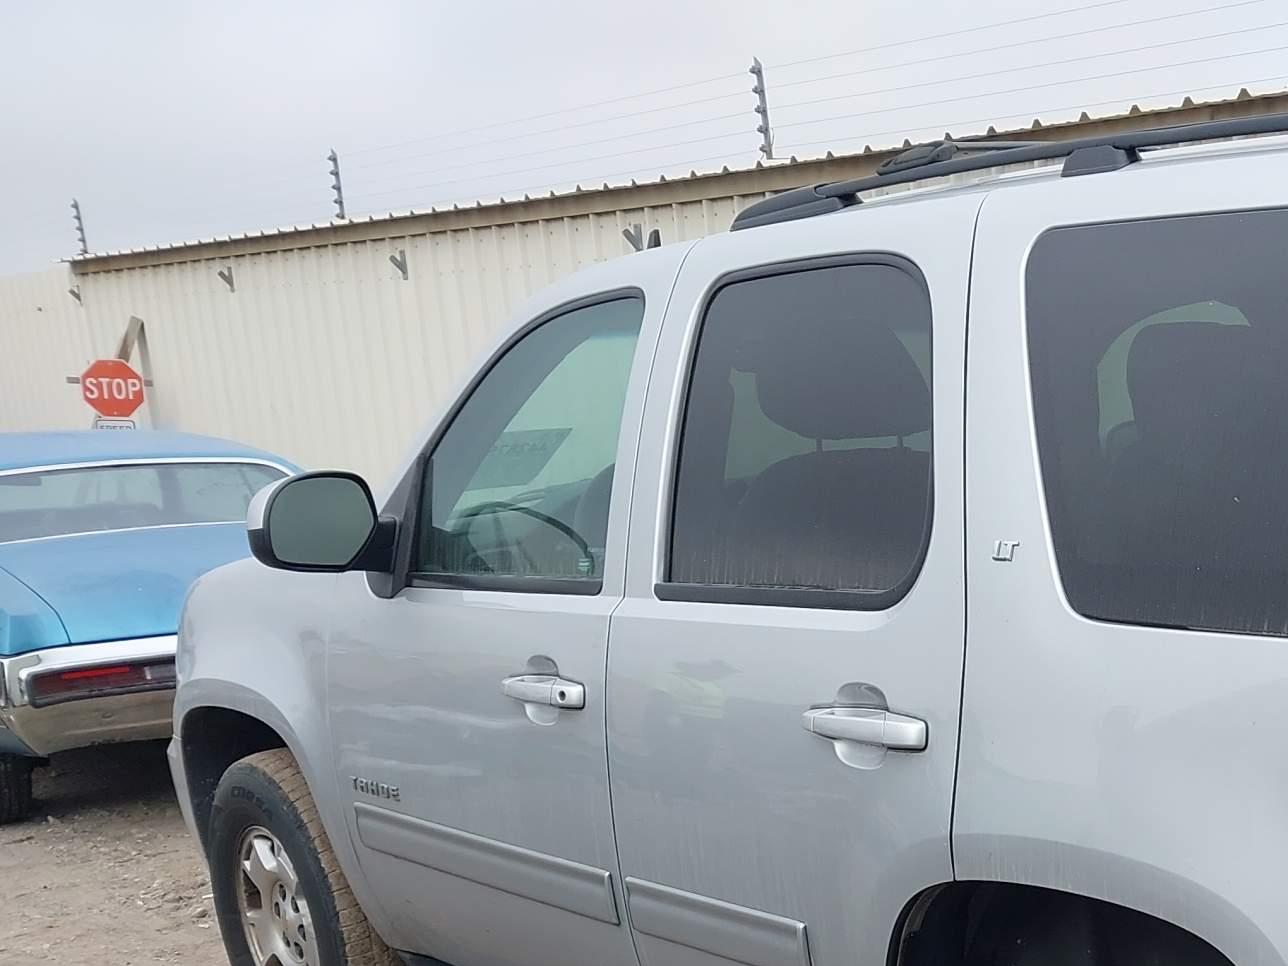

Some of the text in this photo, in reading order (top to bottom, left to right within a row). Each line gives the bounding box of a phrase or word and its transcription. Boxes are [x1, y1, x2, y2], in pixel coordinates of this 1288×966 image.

[85, 377, 141, 400] STOP
[991, 540, 1020, 562] LT
[350, 776, 401, 802] TAHOE
